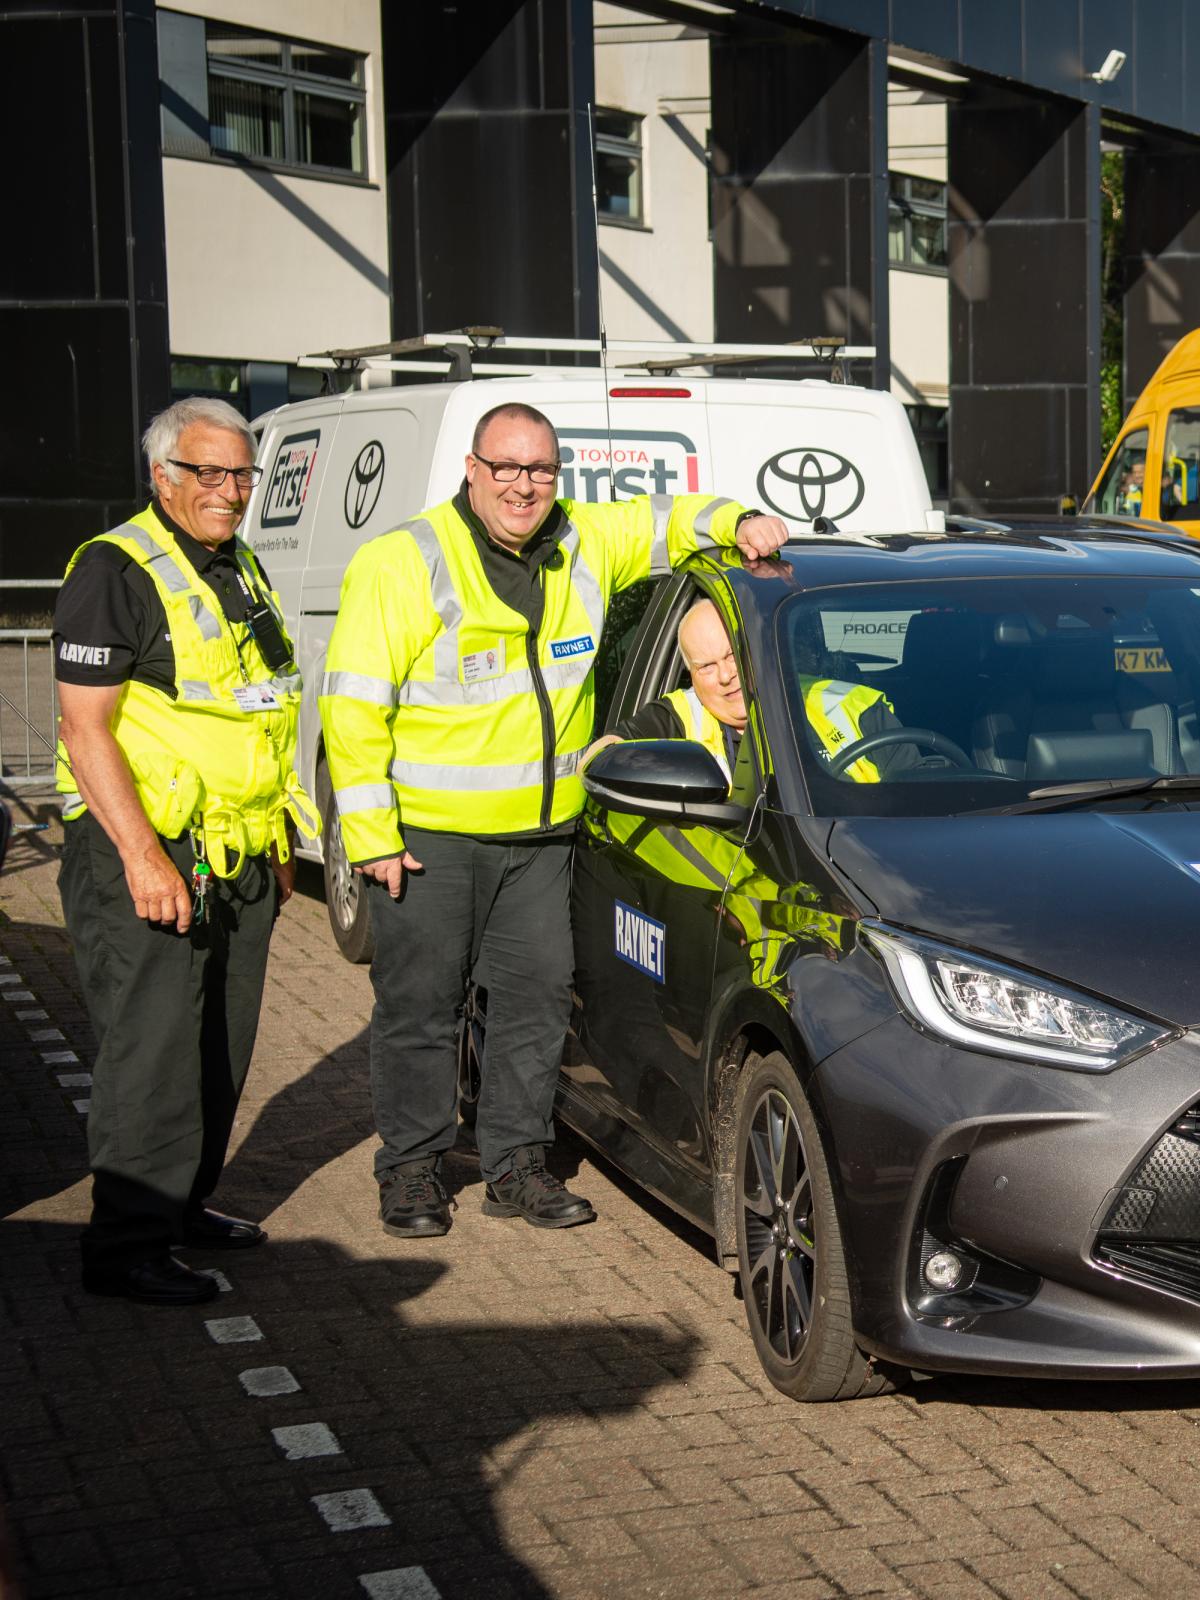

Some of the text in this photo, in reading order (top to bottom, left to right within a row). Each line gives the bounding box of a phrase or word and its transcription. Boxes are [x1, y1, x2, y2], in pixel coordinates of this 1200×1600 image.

[577, 448, 649, 464] TOYOTA
[843, 622, 907, 635] PROACE
[60, 641, 111, 666] RAYNET
[554, 638, 591, 657] RAYNET
[615, 904, 664, 977] RAYNET
